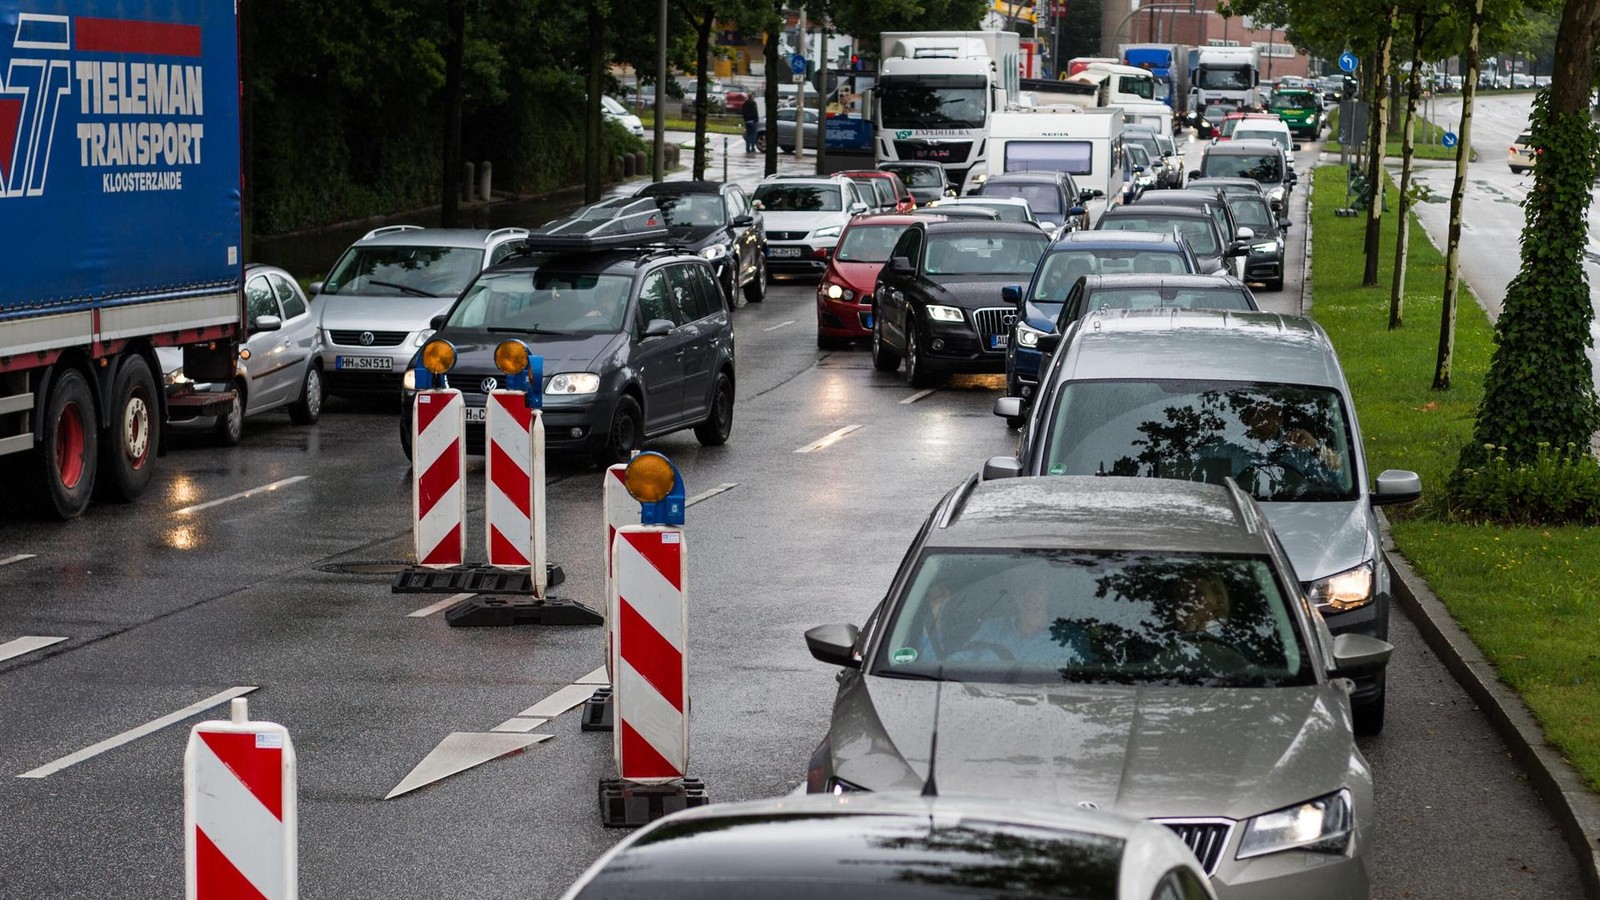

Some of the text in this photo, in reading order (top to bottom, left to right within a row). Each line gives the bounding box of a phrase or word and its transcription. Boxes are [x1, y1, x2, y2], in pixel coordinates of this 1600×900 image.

[75, 60, 204, 116] TIELEMAN
[76, 121, 204, 167] TRANSPORT
[916, 149, 950, 158] MAN
[102, 171, 182, 194] KLOOSTERZANDE
[341, 358, 354, 368] HH
